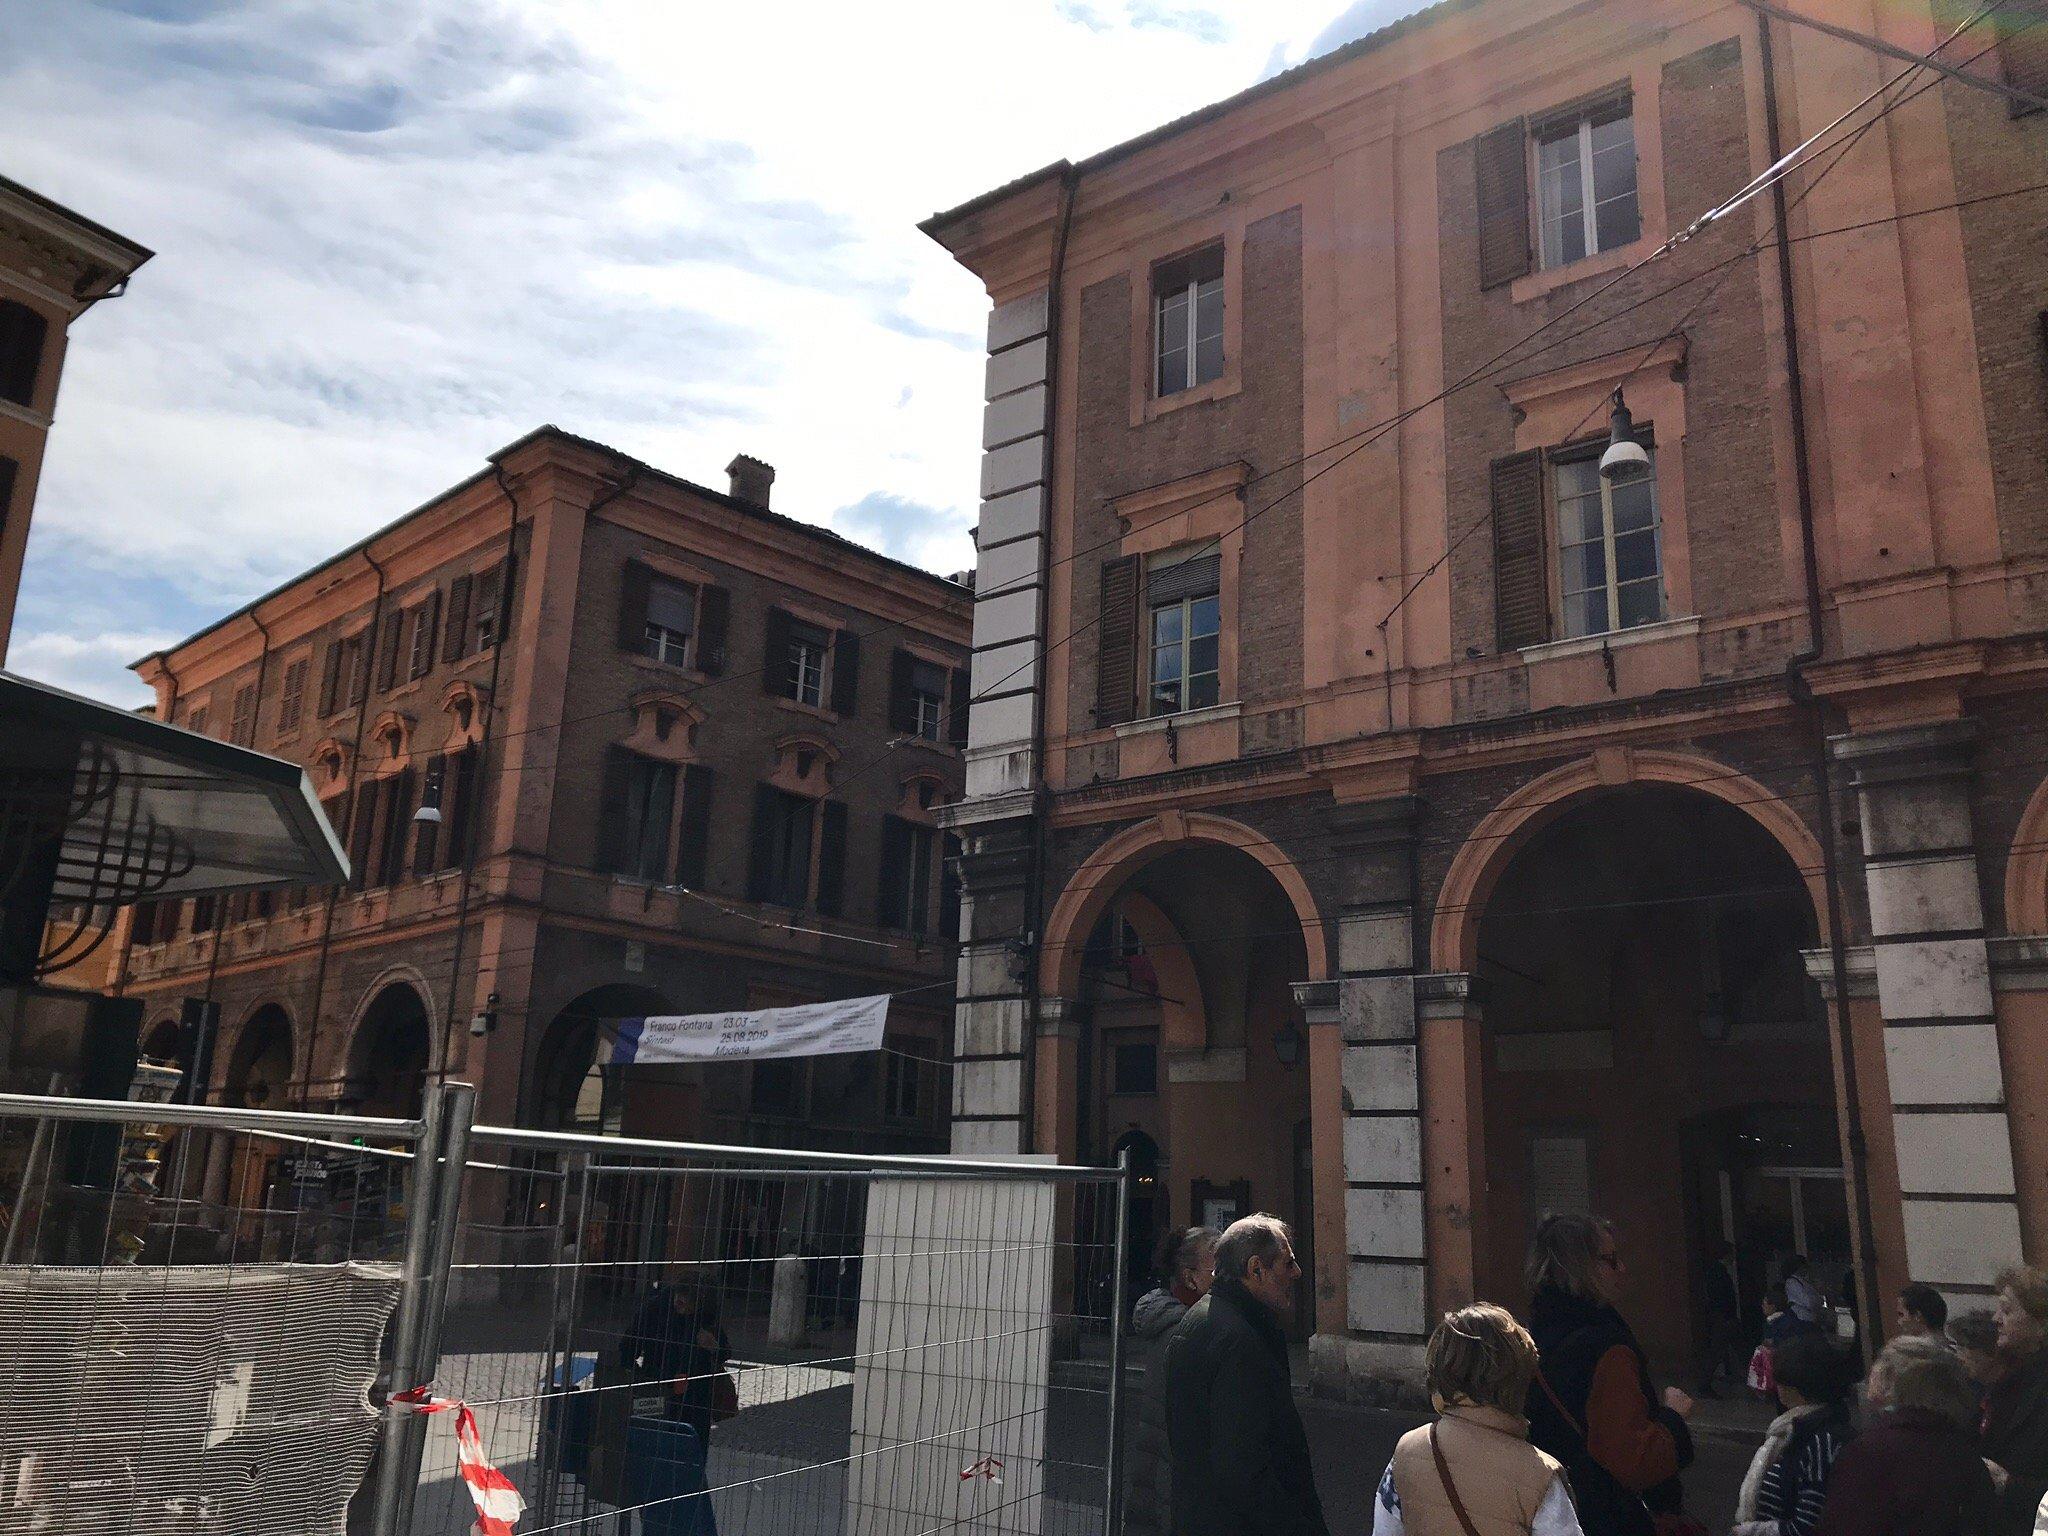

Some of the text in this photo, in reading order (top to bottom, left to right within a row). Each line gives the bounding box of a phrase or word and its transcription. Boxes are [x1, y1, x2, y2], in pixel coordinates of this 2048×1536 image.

[650, 1019, 713, 1032] Franco Fontana
[723, 1017, 748, 1029] 23.03
[720, 1030, 769, 1044] 25.08.2019
[712, 1045, 751, 1057] Modena
